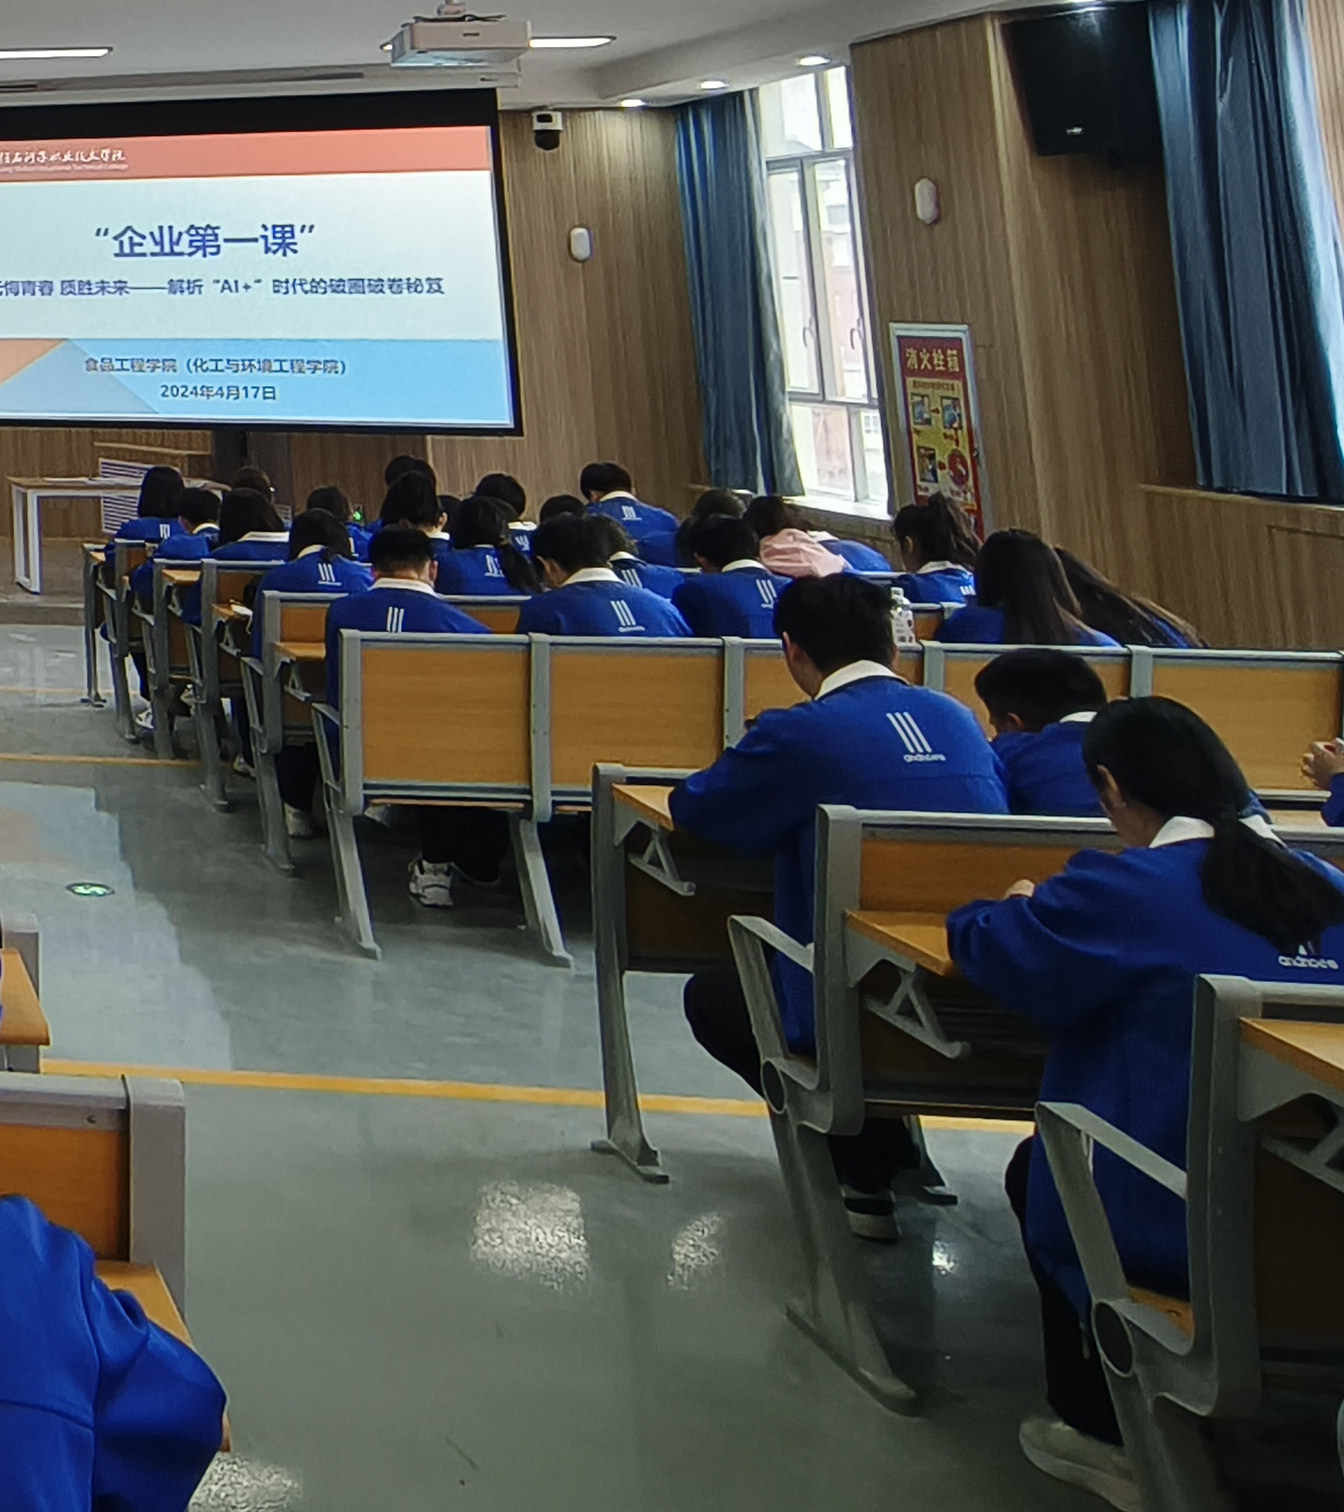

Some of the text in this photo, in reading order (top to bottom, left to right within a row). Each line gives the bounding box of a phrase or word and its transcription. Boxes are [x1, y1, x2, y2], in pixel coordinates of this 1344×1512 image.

[94, 223, 316, 258] “企业第一课”
[160, 384, 277, 401] 2024年4月17日
